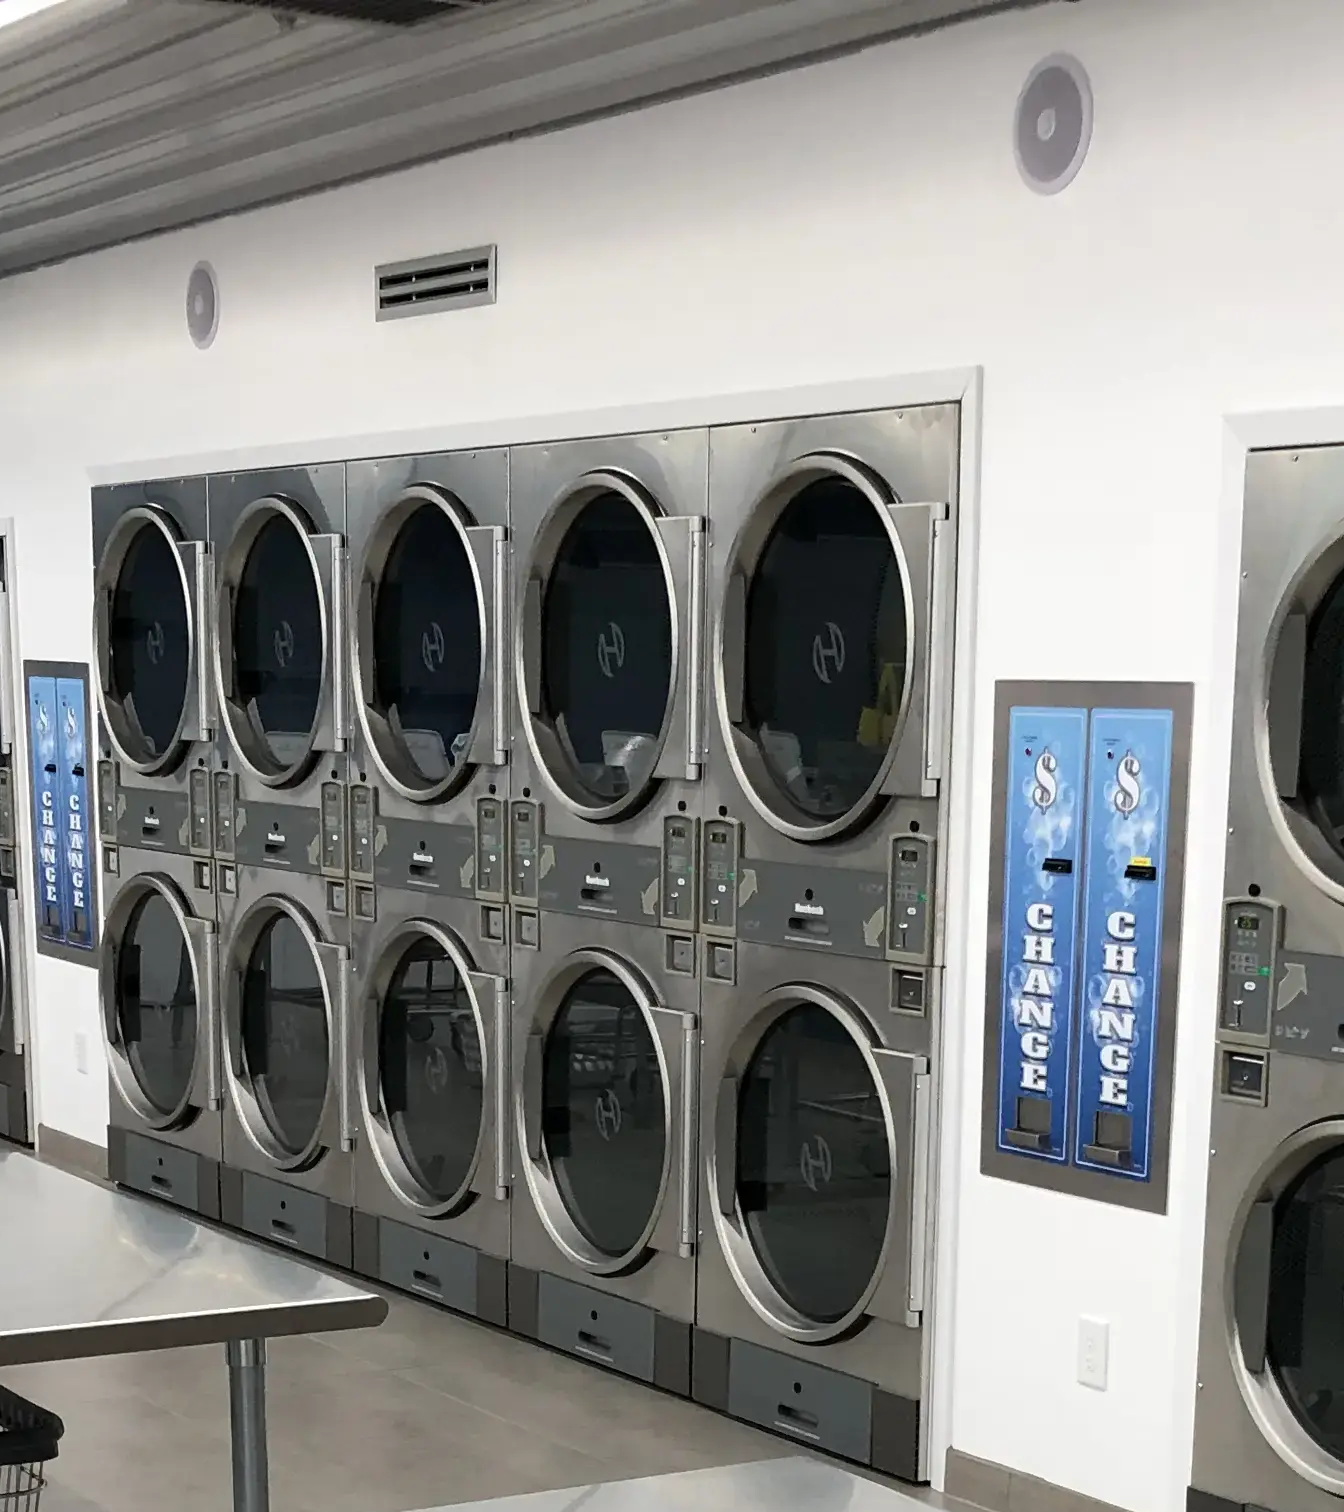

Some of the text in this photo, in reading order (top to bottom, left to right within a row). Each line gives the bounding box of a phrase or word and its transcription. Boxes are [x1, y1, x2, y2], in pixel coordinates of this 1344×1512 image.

[40, 791, 57, 903] CHANGE
[68, 794, 85, 909] CHANGE
[1018, 903, 1056, 1093] CHANGE
[1098, 911, 1137, 1107] CHANGE
